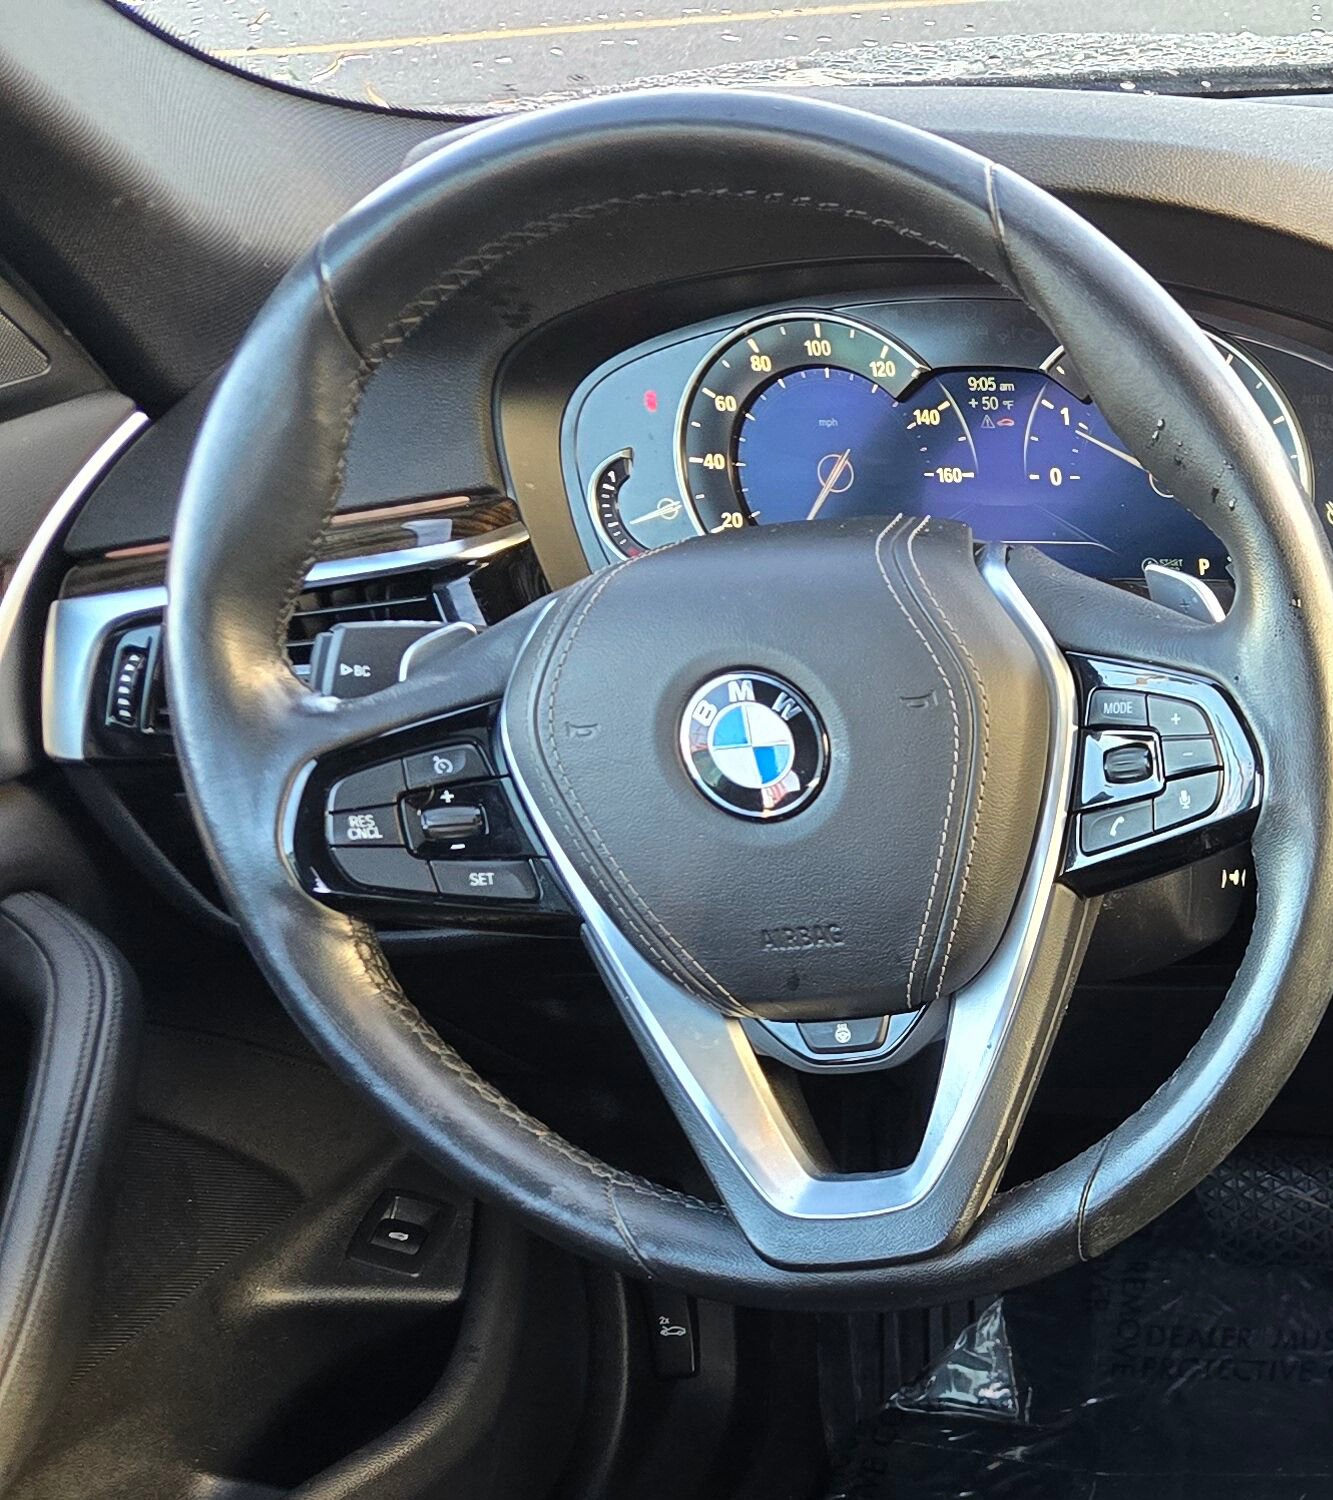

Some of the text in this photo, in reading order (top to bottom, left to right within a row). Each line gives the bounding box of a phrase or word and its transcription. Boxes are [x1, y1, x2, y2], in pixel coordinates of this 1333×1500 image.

[804, 340, 832, 357] 100
[750, 355, 772, 373] 80
[869, 360, 896, 378] 120
[967, 376, 997, 392] 9:05
[714, 394, 738, 412] 60
[818, 418, 839, 429] mph
[913, 408, 941, 426] 140
[703, 453, 726, 470] 40
[935, 467, 963, 484] 160
[1049, 466, 1063, 487] 0
[721, 512, 744, 529] 20
[1198, 558, 1210, 576] P
[692, 679, 803, 727] BMW
[1103, 701, 1133, 714] MODE
[347, 814, 375, 828] RES
[346, 827, 383, 841] CNCL
[468, 872, 495, 887] SET
[761, 924, 846, 952] AIRBAG
